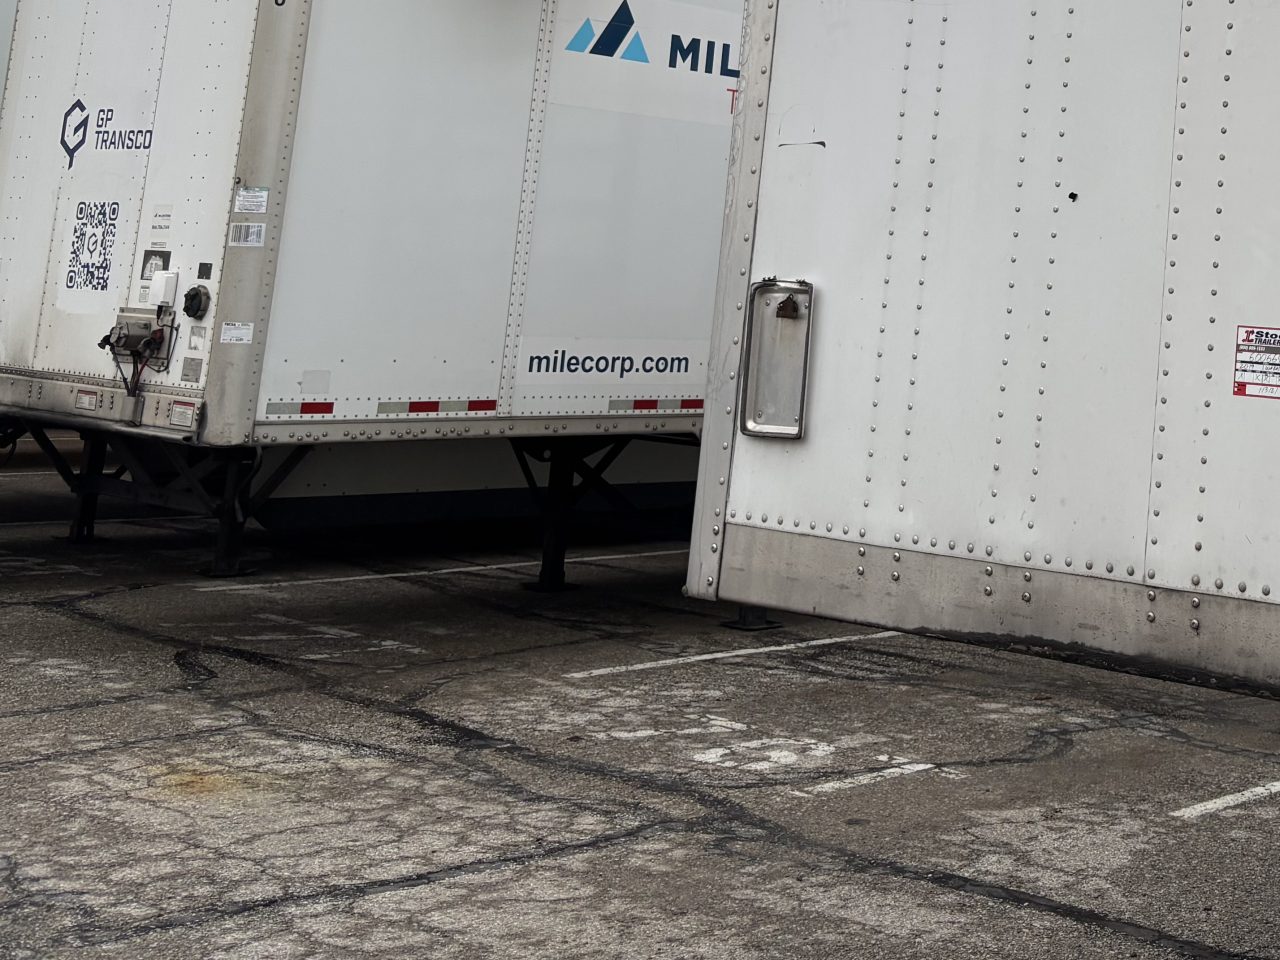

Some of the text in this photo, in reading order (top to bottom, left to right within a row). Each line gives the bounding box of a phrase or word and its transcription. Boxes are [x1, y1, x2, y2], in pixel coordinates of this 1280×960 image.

[96, 108, 114, 128] GP
[94, 129, 153, 151] TRANSCO
[528, 349, 690, 379] milecorp.com
